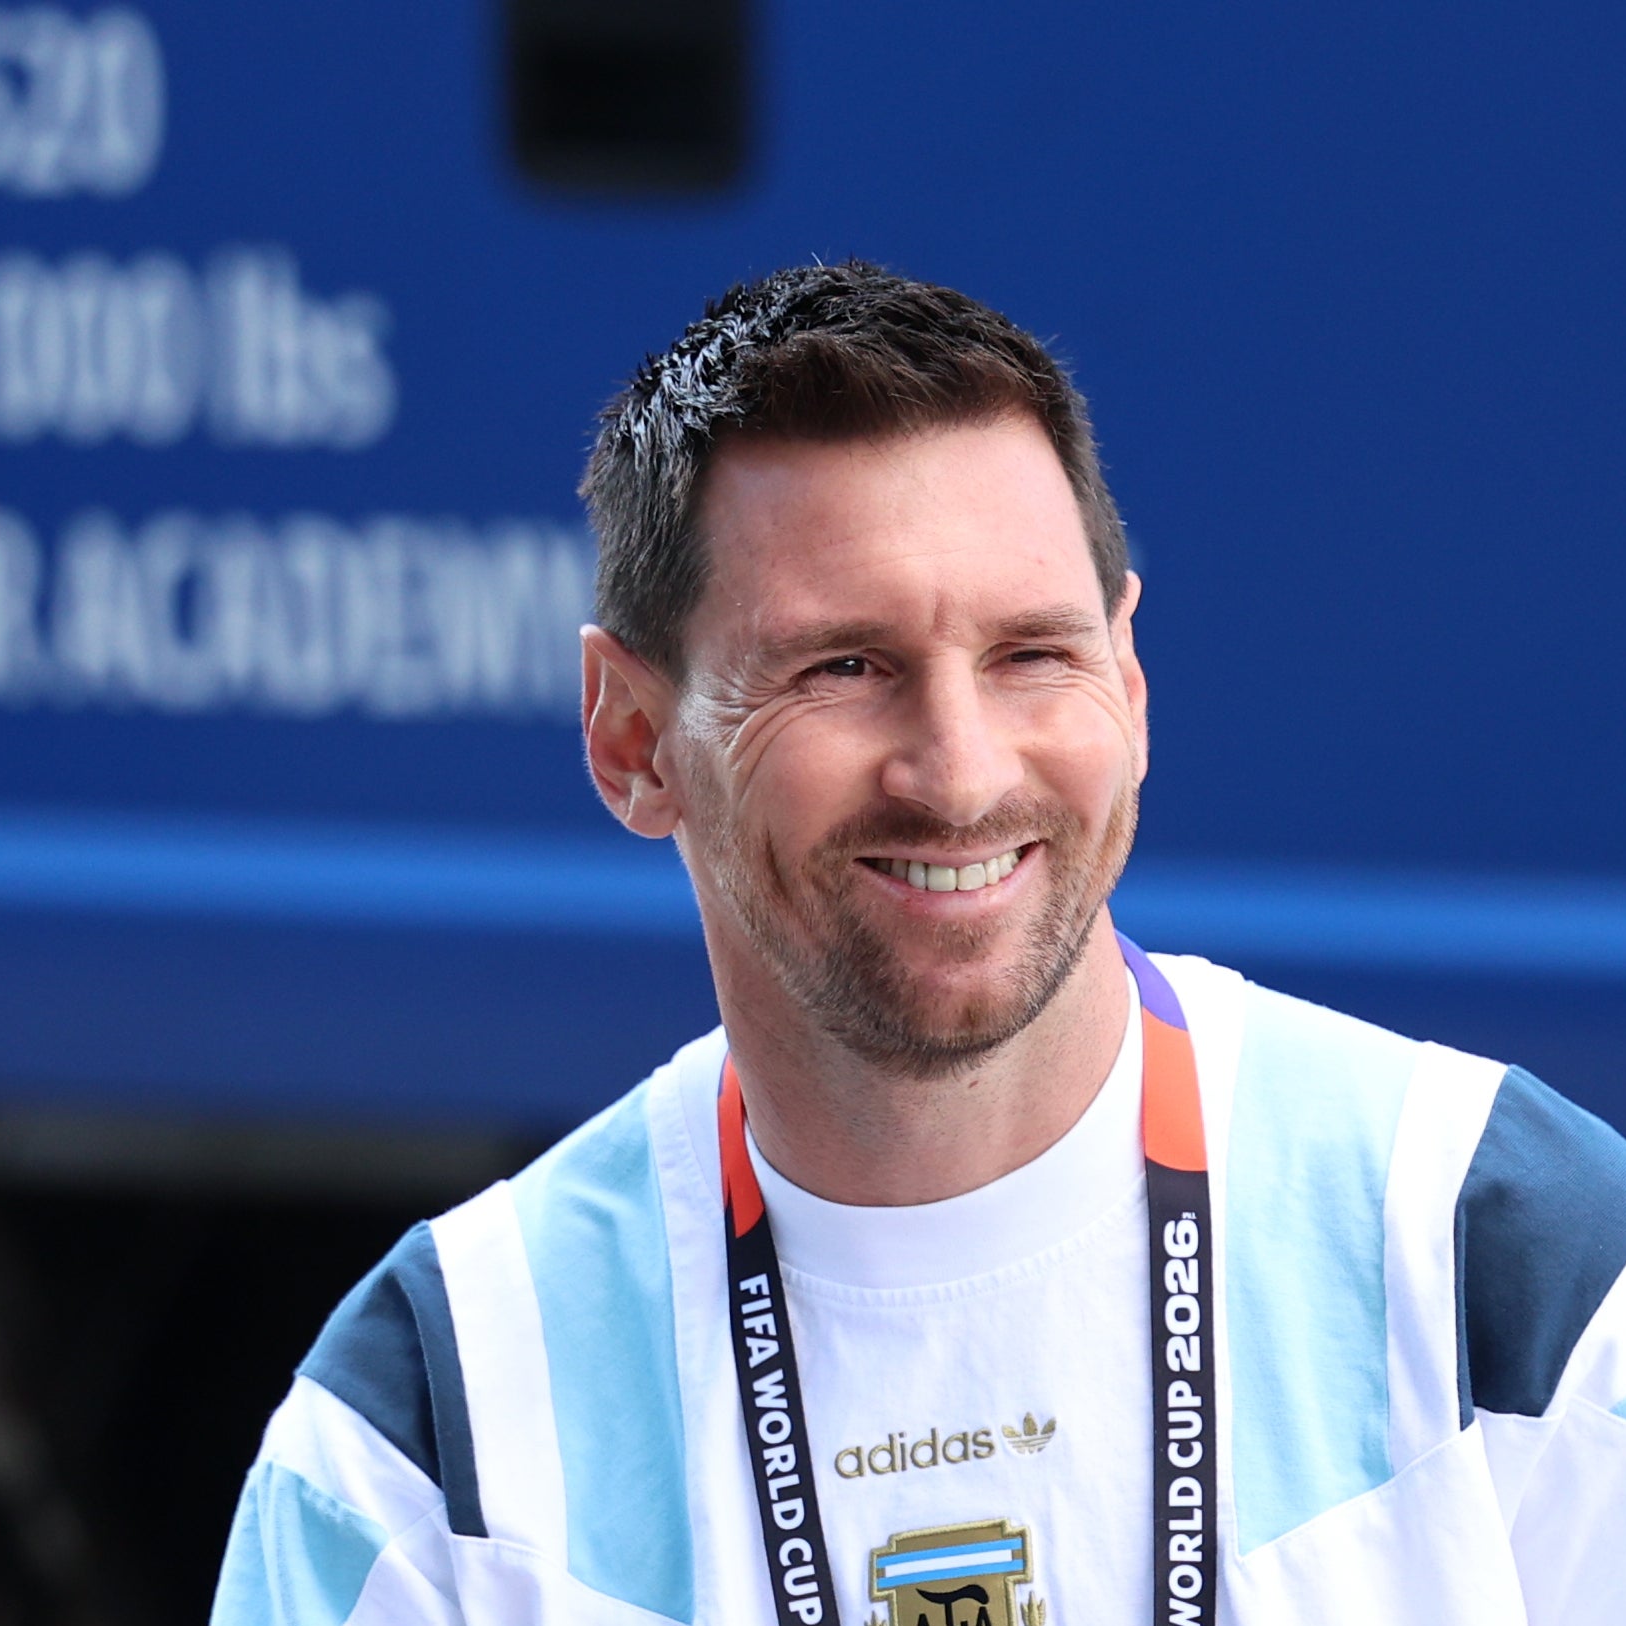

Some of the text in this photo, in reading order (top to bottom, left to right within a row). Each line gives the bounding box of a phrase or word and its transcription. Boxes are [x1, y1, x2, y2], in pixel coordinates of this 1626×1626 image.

[211, 245, 395, 447] lbs
[739, 1273, 780, 1368] FIFA
[752, 1368, 805, 1531] WORLD
[833, 1424, 996, 1480] adidas
[1167, 1379, 1204, 1468] CUP
[778, 1537, 824, 1626] CUP
